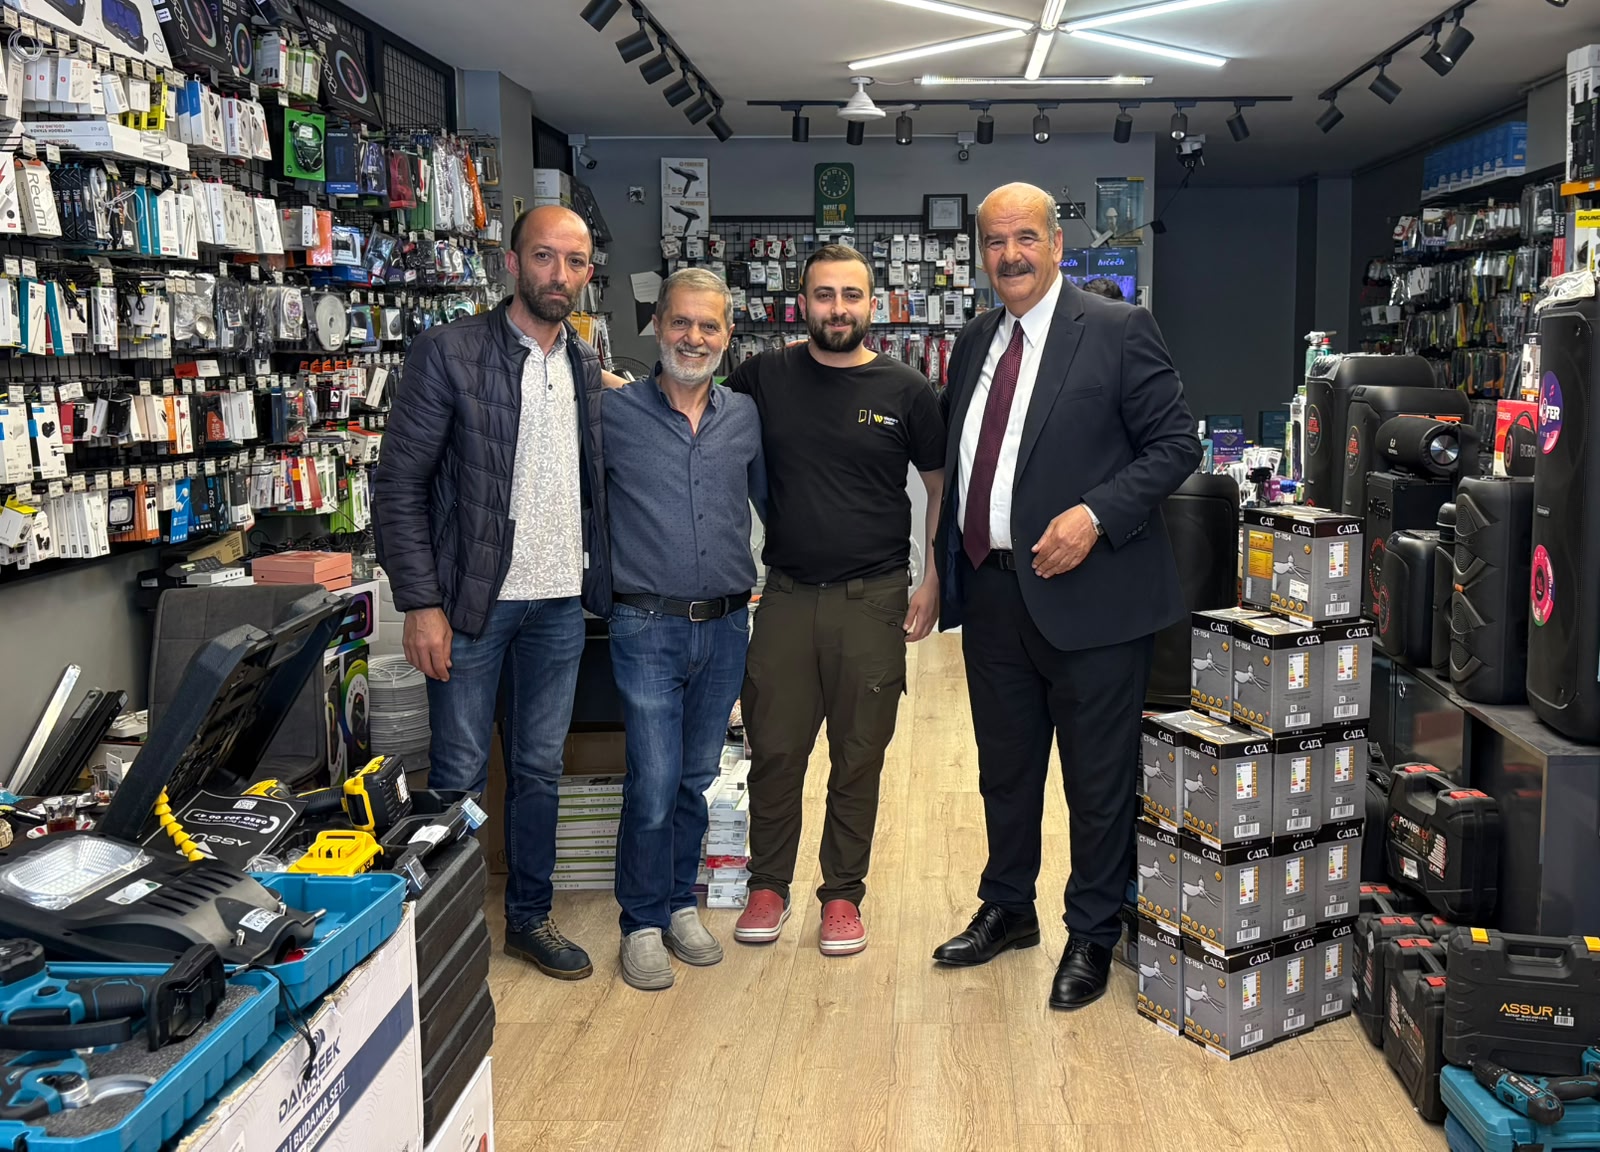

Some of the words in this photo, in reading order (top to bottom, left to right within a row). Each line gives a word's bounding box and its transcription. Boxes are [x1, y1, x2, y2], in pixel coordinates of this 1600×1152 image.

[1260, 516, 1274, 526] CAT
[1292, 524, 1311, 536] CATA
[1337, 523, 1360, 535] CATA
[1210, 622, 1229, 634] CATA
[1346, 627, 1370, 638] CATA
[1251, 634, 1270, 647] CATA
[1296, 634, 1321, 646] CATA
[1158, 730, 1174, 744] CATA
[1343, 728, 1365, 740] CATA
[1200, 743, 1216, 757] CATA
[1244, 743, 1268, 755] CATA
[1299, 738, 1322, 750] CATA
[189, 833, 251, 846] ASSU
[1156, 832, 1176, 846] CATA
[1336, 827, 1359, 840] CATA
[1293, 838, 1314, 851] CATA
[1202, 848, 1221, 863] CATA
[1247, 847, 1269, 861] CATA
[1332, 924, 1351, 938] CATA
[1157, 932, 1176, 947] CATA
[1294, 938, 1314, 952] CATA
[1203, 955, 1224, 970] CATA
[1249, 951, 1270, 966] CATA
[1499, 1003, 1553, 1017] ASSUR
[302, 1080, 322, 1109] TECH
[293, 1097, 329, 1150] BUDAMA
